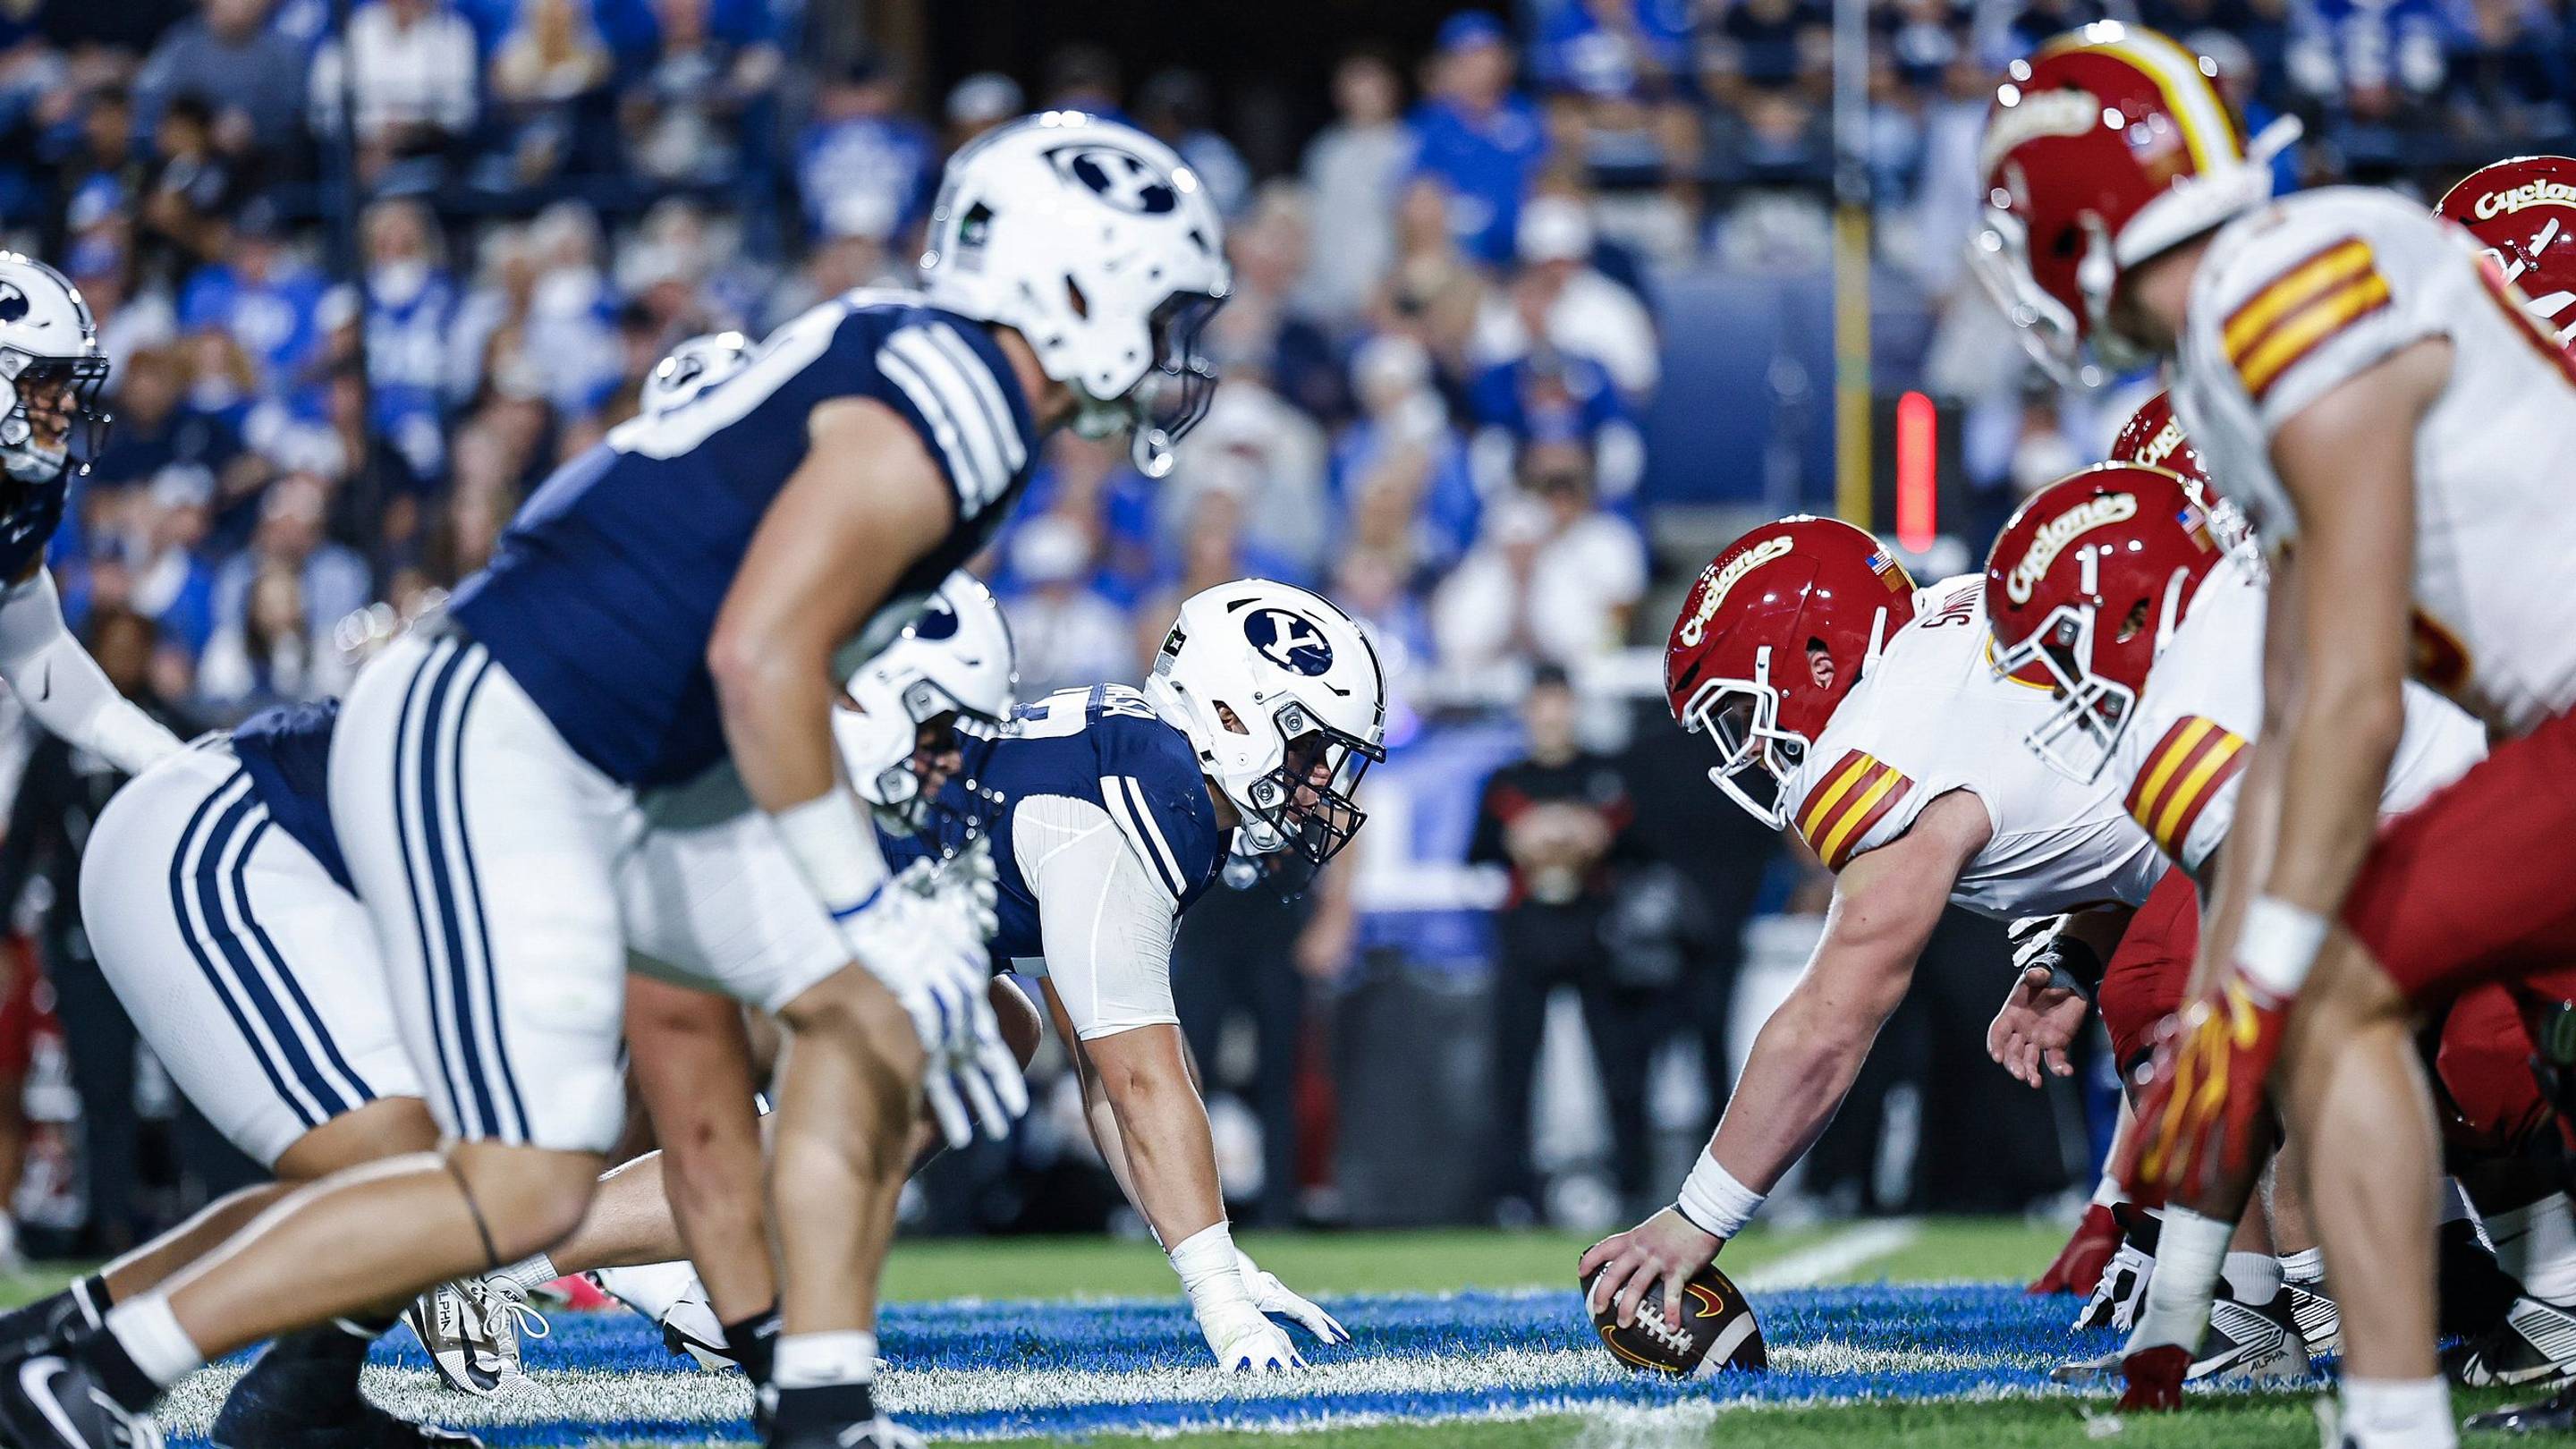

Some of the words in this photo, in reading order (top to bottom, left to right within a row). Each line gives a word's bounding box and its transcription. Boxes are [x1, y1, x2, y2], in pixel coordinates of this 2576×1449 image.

[2475, 179, 2576, 220] Cyclo
[2135, 414, 2188, 469] Cycl
[2007, 493, 2138, 605] Cyclones
[1681, 536, 1794, 648] Cyclones
[2250, 1350, 2290, 1374] ALPHA
